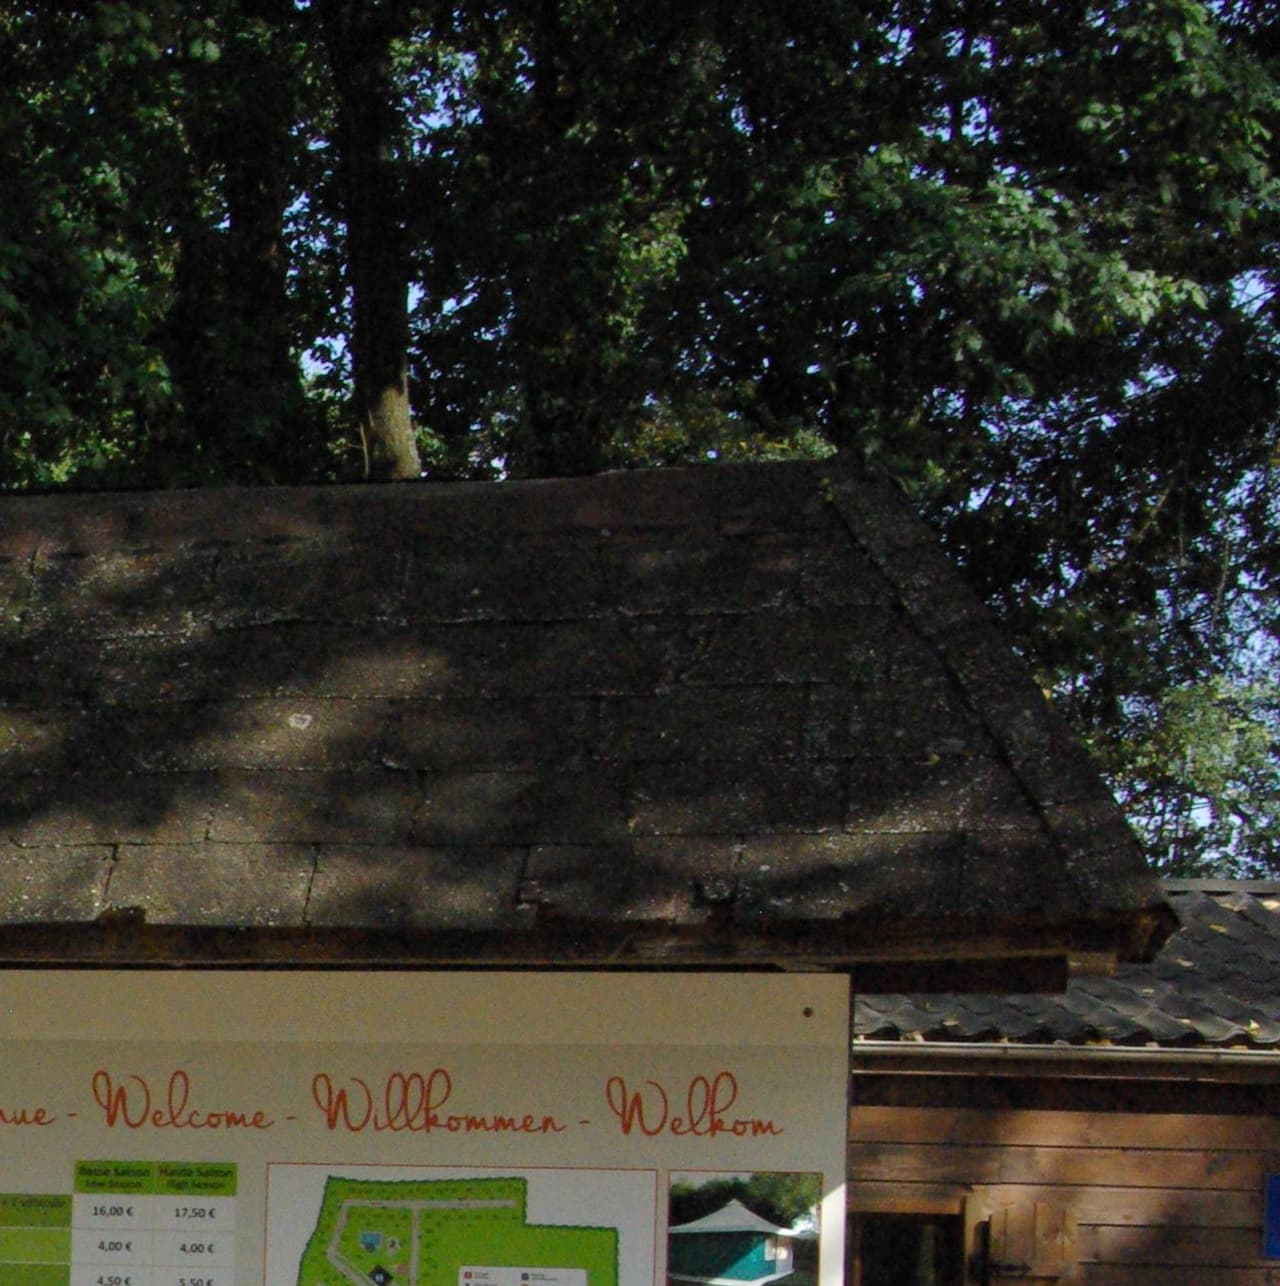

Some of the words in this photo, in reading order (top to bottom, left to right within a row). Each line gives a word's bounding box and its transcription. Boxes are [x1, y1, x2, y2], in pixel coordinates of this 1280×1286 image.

[91, 1069, 275, 1130] Welcome
[311, 1067, 570, 1134] Willkommen
[606, 1070, 784, 1140] Welkom
[92, 1206, 124, 1218] 16,00
[126, 1206, 135, 1217] €
[175, 1207, 206, 1219] 17,50
[208, 1208, 216, 1218] €
[98, 1241, 123, 1253] 4,00
[125, 1242, 133, 1252] €
[179, 1243, 205, 1255] 4,00
[207, 1244, 215, 1254] €
[124, 1277, 132, 1286] €
